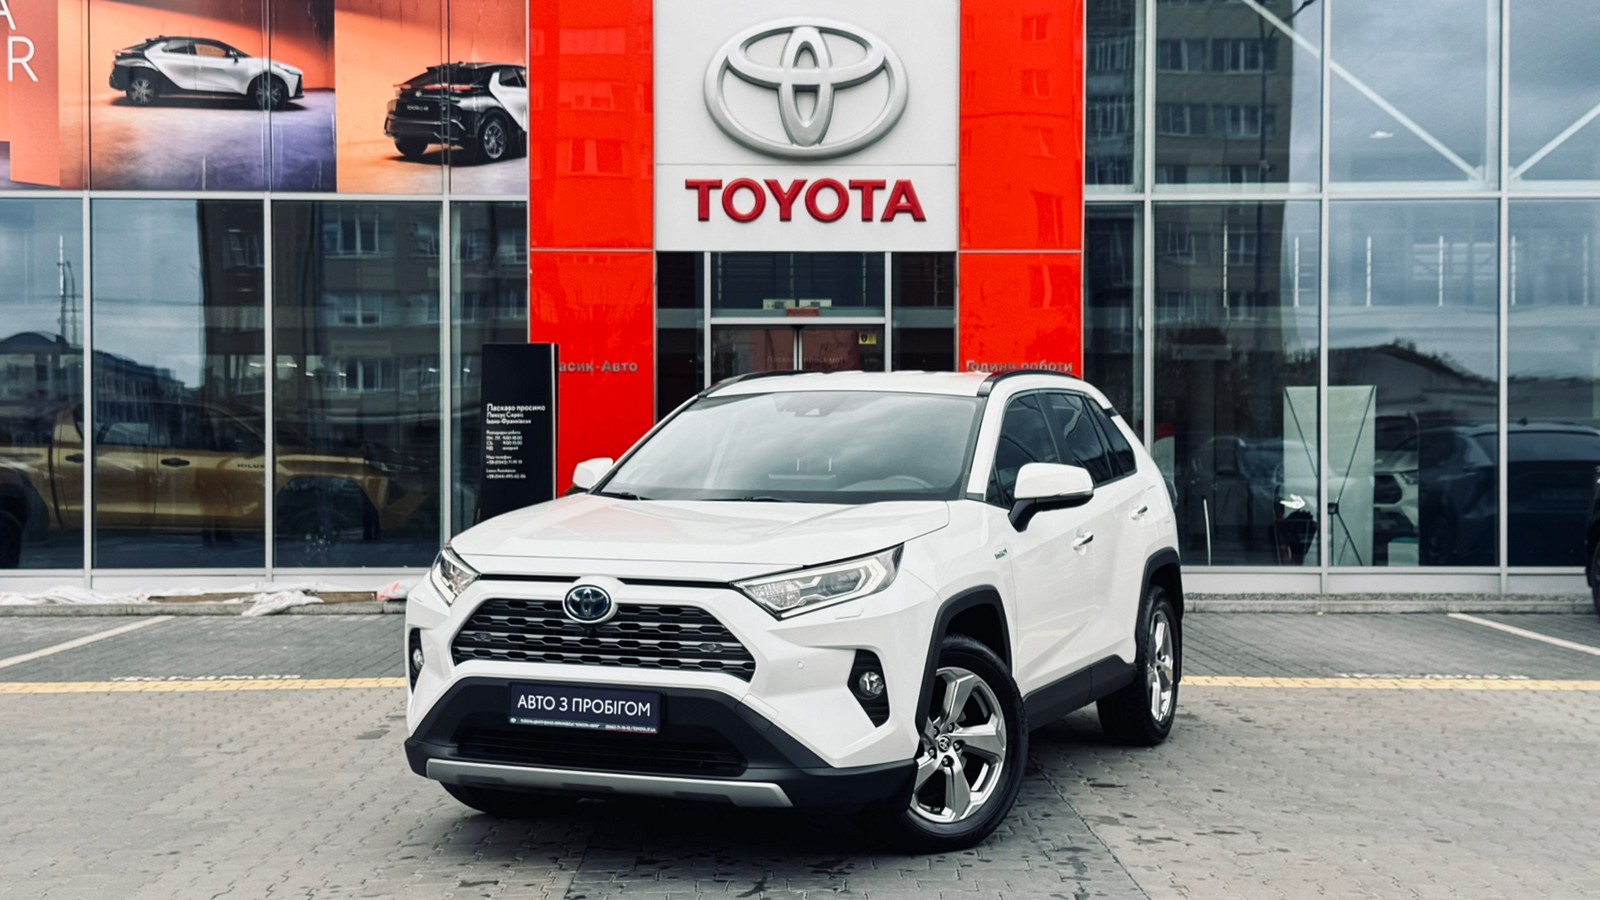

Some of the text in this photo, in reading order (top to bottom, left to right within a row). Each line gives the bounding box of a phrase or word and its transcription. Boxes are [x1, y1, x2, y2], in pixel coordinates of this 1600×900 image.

[685, 177, 927, 224] TOYOTA
[517, 694, 556, 711] АВТО
[571, 698, 651, 717] ПРОБІГОМ
